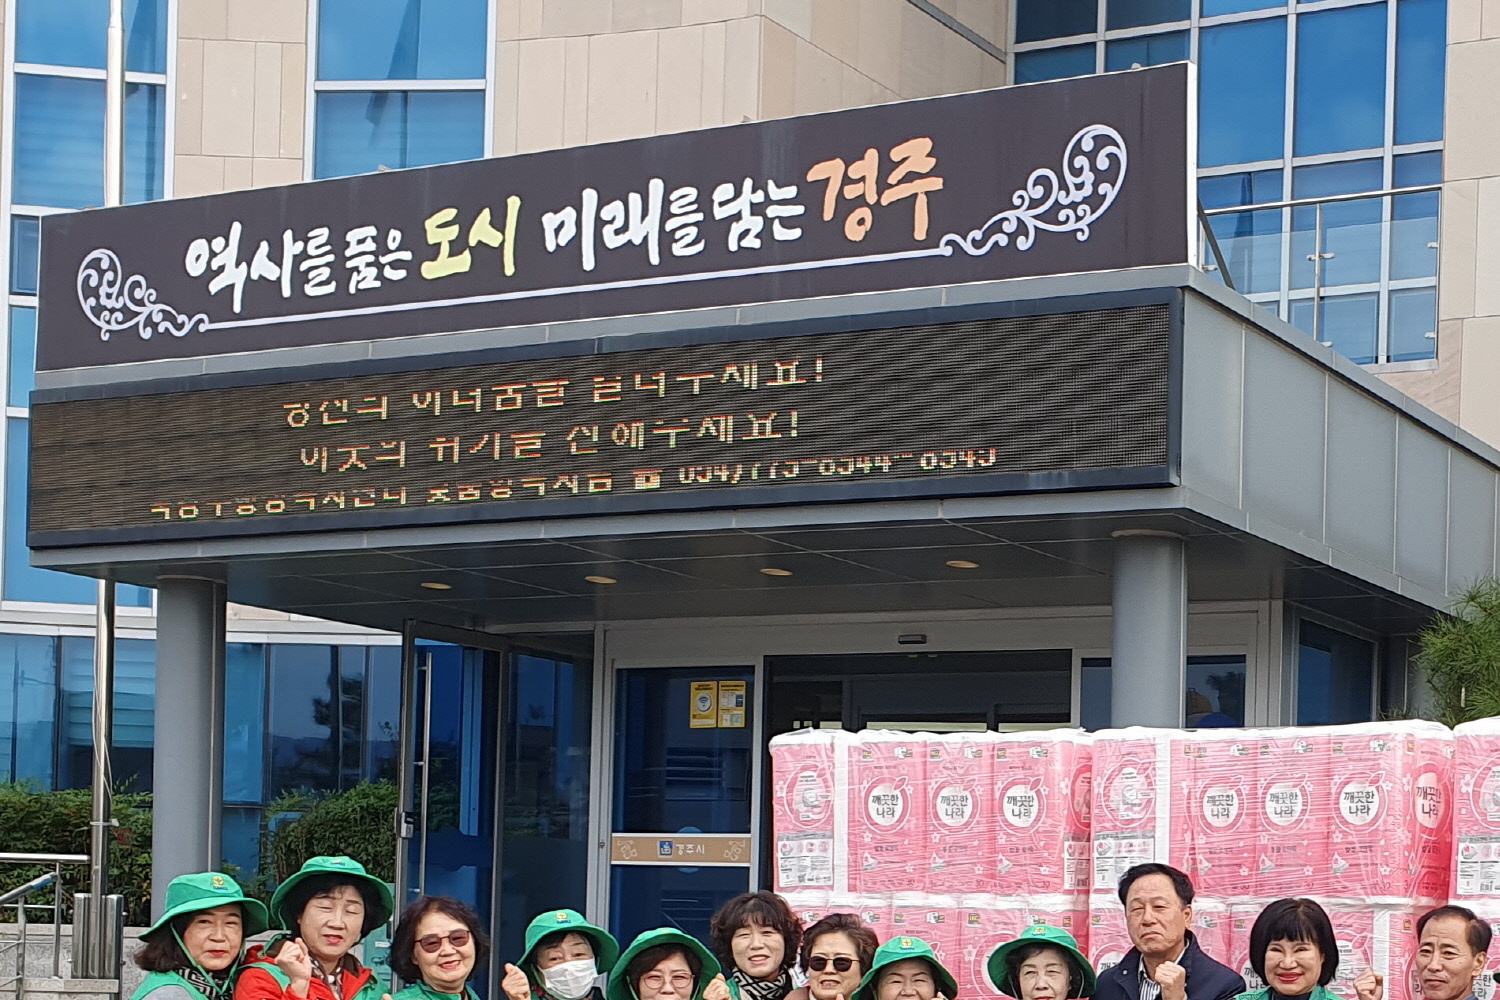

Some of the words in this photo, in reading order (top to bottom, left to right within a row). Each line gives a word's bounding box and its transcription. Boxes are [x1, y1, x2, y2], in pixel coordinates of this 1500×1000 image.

[420, 195, 520, 280] 도시
[544, 177, 705, 272] 미래를
[712, 176, 806, 253] 담는
[806, 136, 944, 241] 경주
[872, 794, 899, 807] 깨끗한
[940, 794, 969, 807] 깨끗한
[1006, 795, 1034, 807] 깨끗한
[1206, 794, 1234, 807] 깨끗한
[1268, 791, 1298, 805] 깨끗한
[1343, 791, 1375, 804] 깨끗한
[876, 807, 895, 819] 나라
[945, 807, 965, 819] 나라
[1011, 807, 1032, 819] 나라
[1211, 807, 1230, 819] 나라
[1274, 805, 1294, 817] 나라
[1349, 805, 1371, 817] 나라
